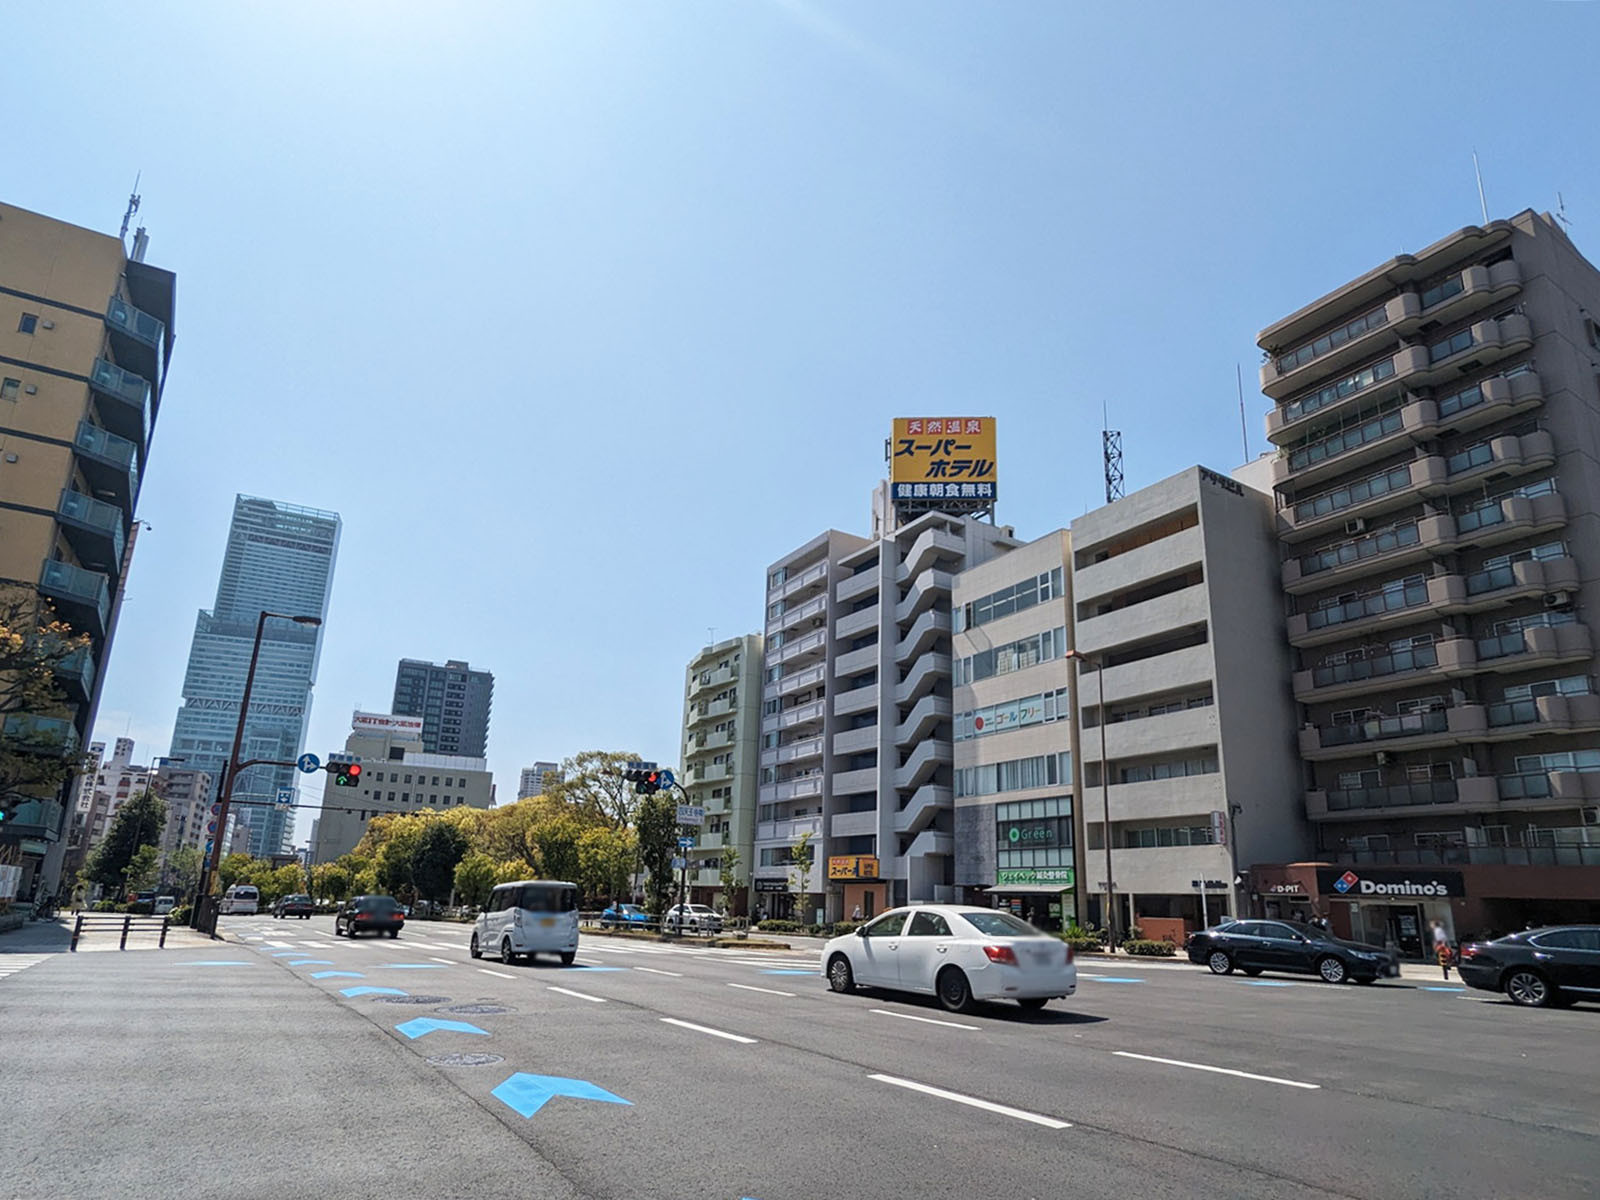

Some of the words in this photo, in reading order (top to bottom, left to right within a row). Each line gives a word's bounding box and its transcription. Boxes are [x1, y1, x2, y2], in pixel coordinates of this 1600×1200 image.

[909, 420, 981, 434] 天然温泉
[894, 439, 972, 457] スーパー
[925, 459, 994, 478] ホテル
[898, 483, 992, 497] 健康朝食無料
[1021, 828, 1052, 840] Green
[1360, 880, 1448, 896] Domino's
